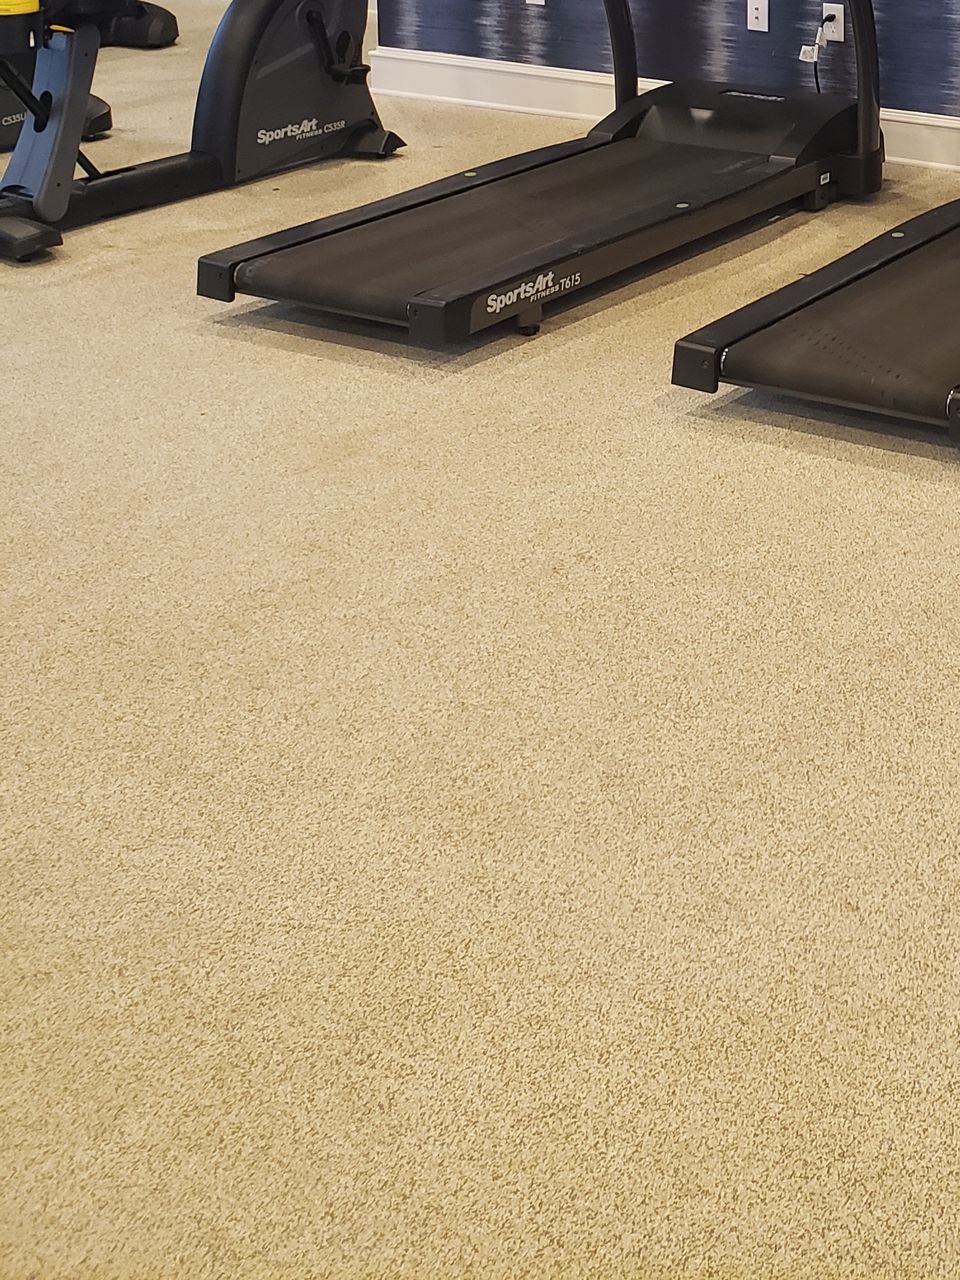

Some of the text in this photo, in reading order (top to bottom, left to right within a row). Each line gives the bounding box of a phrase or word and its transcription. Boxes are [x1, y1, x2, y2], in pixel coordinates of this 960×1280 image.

[256, 118, 318, 145] SportsArt
[296, 129, 322, 141] FITNESS
[486, 271, 581, 314] SportsArt T615
[529, 284, 560, 303] FITNESS
